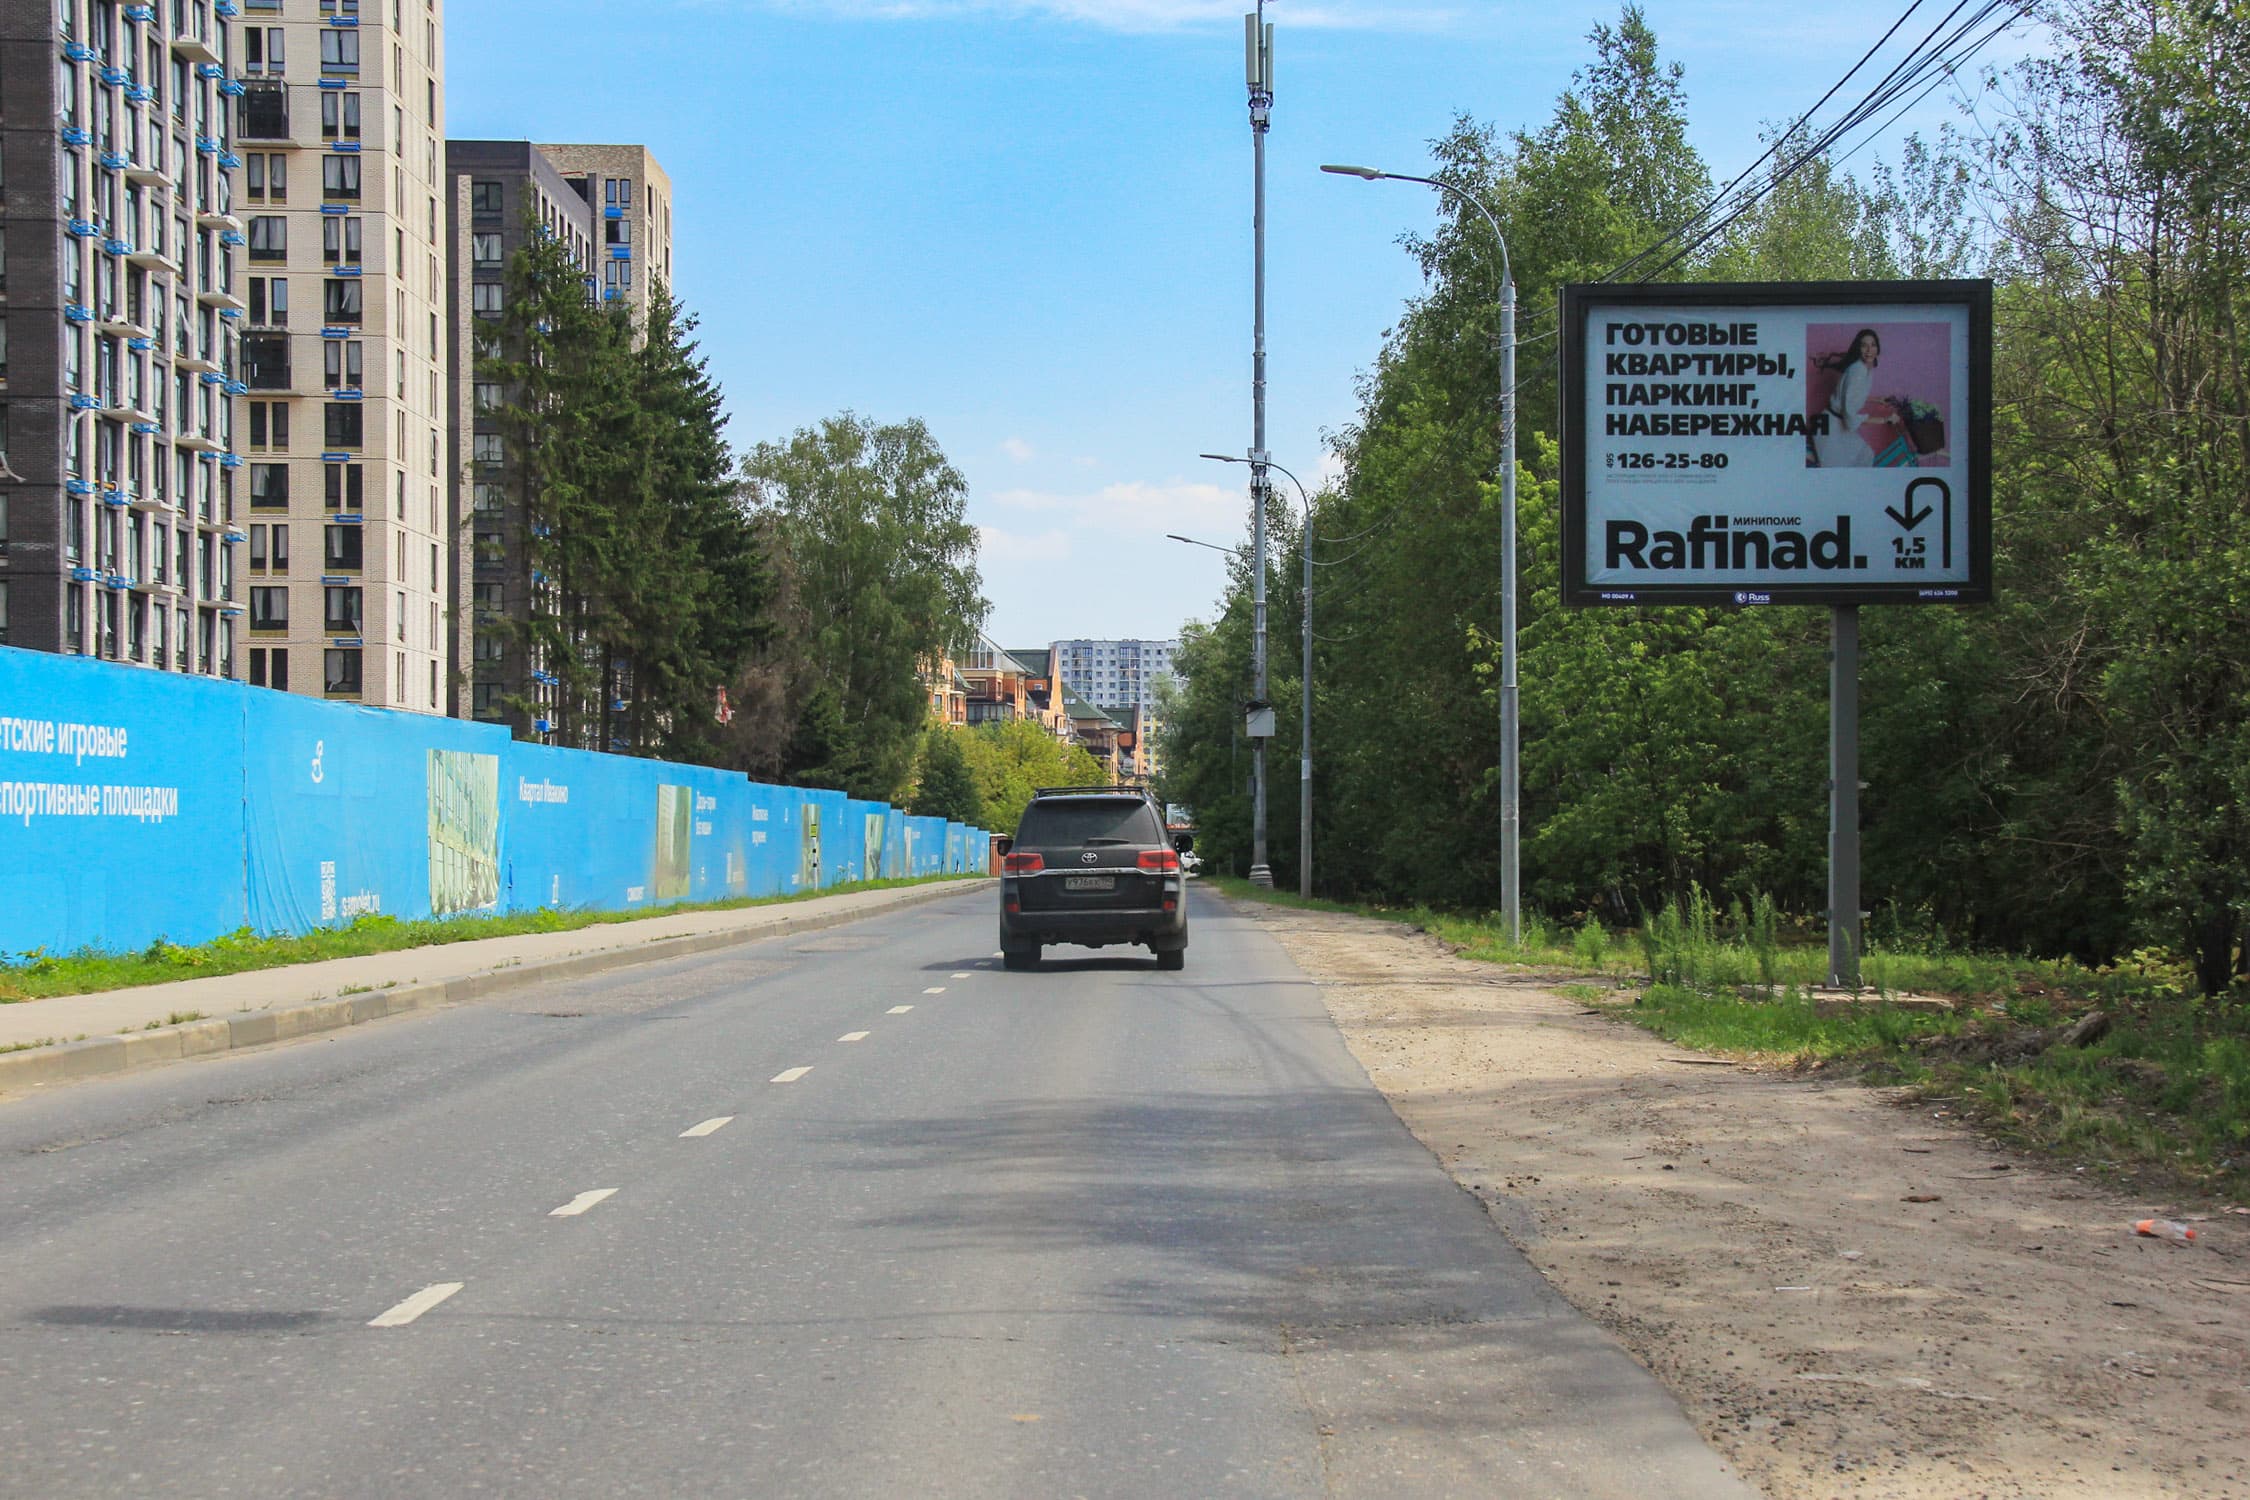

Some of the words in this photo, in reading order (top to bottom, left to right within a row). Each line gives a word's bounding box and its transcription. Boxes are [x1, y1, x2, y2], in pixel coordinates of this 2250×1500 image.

[1606, 323, 1757, 346] ГОТОВЫЕ
[1606, 353, 1795, 378] КВАРТИРЫ,
[1606, 383, 1759, 409] ПАРКИНГ,
[1606, 413, 1829, 436] НАБЕРЕЖНАЯ
[1606, 453, 1614, 468] 495
[1617, 453, 1729, 469] 126-25-80
[1733, 517, 1801, 526] МИНИПОЛИС
[1606, 515, 1868, 570] Rafinad.
[1893, 537, 1925, 556] 1,5
[1748, 593, 1770, 601] Russ
[0, 717, 54, 754] тские
[58, 722, 127, 766] игровые
[0, 782, 99, 827] портивные
[103, 786, 178, 824] площадки
